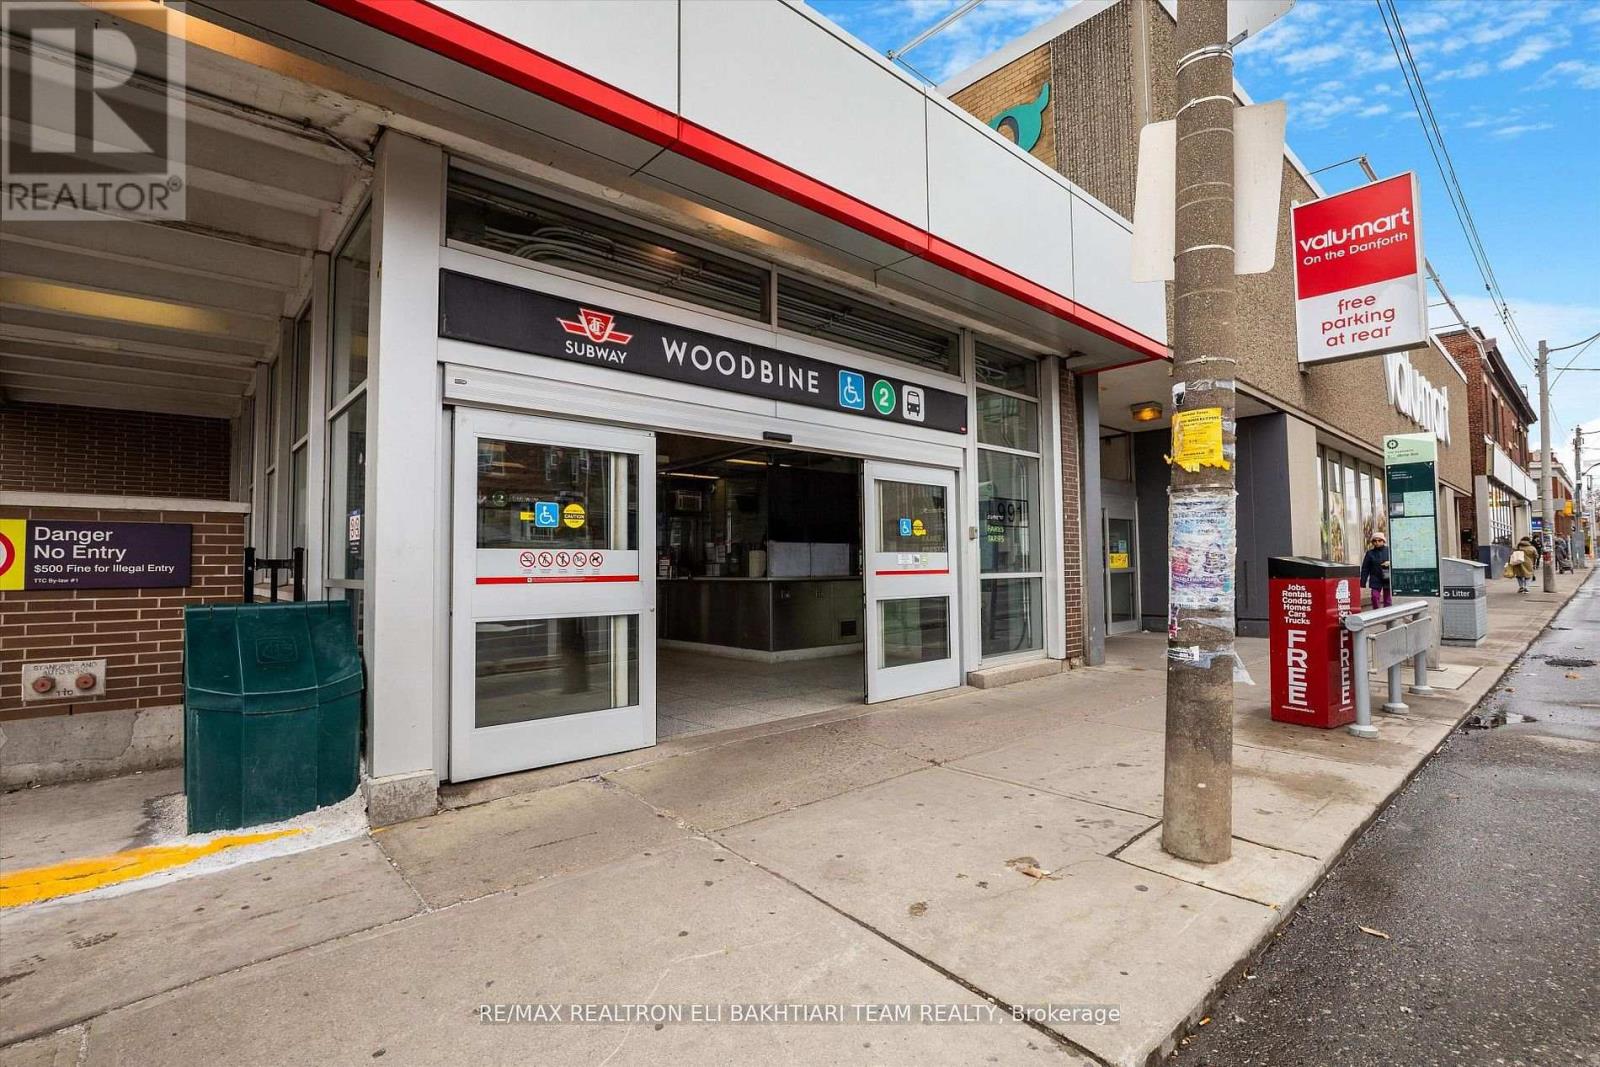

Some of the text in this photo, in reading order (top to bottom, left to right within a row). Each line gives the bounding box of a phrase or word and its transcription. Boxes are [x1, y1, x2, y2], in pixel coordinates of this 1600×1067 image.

[1303, 232, 1409, 267] On the Danforth
[1337, 295, 1376, 315] free
[1322, 306, 1396, 335] parking
[1326, 325, 1392, 348] at rear
[565, 340, 628, 365] SUBWAY
[661, 336, 889, 407] WOODBINE 2
[34, 526, 113, 545] Danger
[34, 545, 127, 562] No Entry
[33, 564, 175, 574] $500 Fine for Illegal Entry
[1282, 590, 1312, 599] Rentals
[1287, 583, 1306, 592] Jobs
[1282, 597, 1313, 605] Condos
[1283, 604, 1312, 612] Homes
[1284, 617, 1311, 625] Trucks
[1287, 629, 1308, 706] FREE
